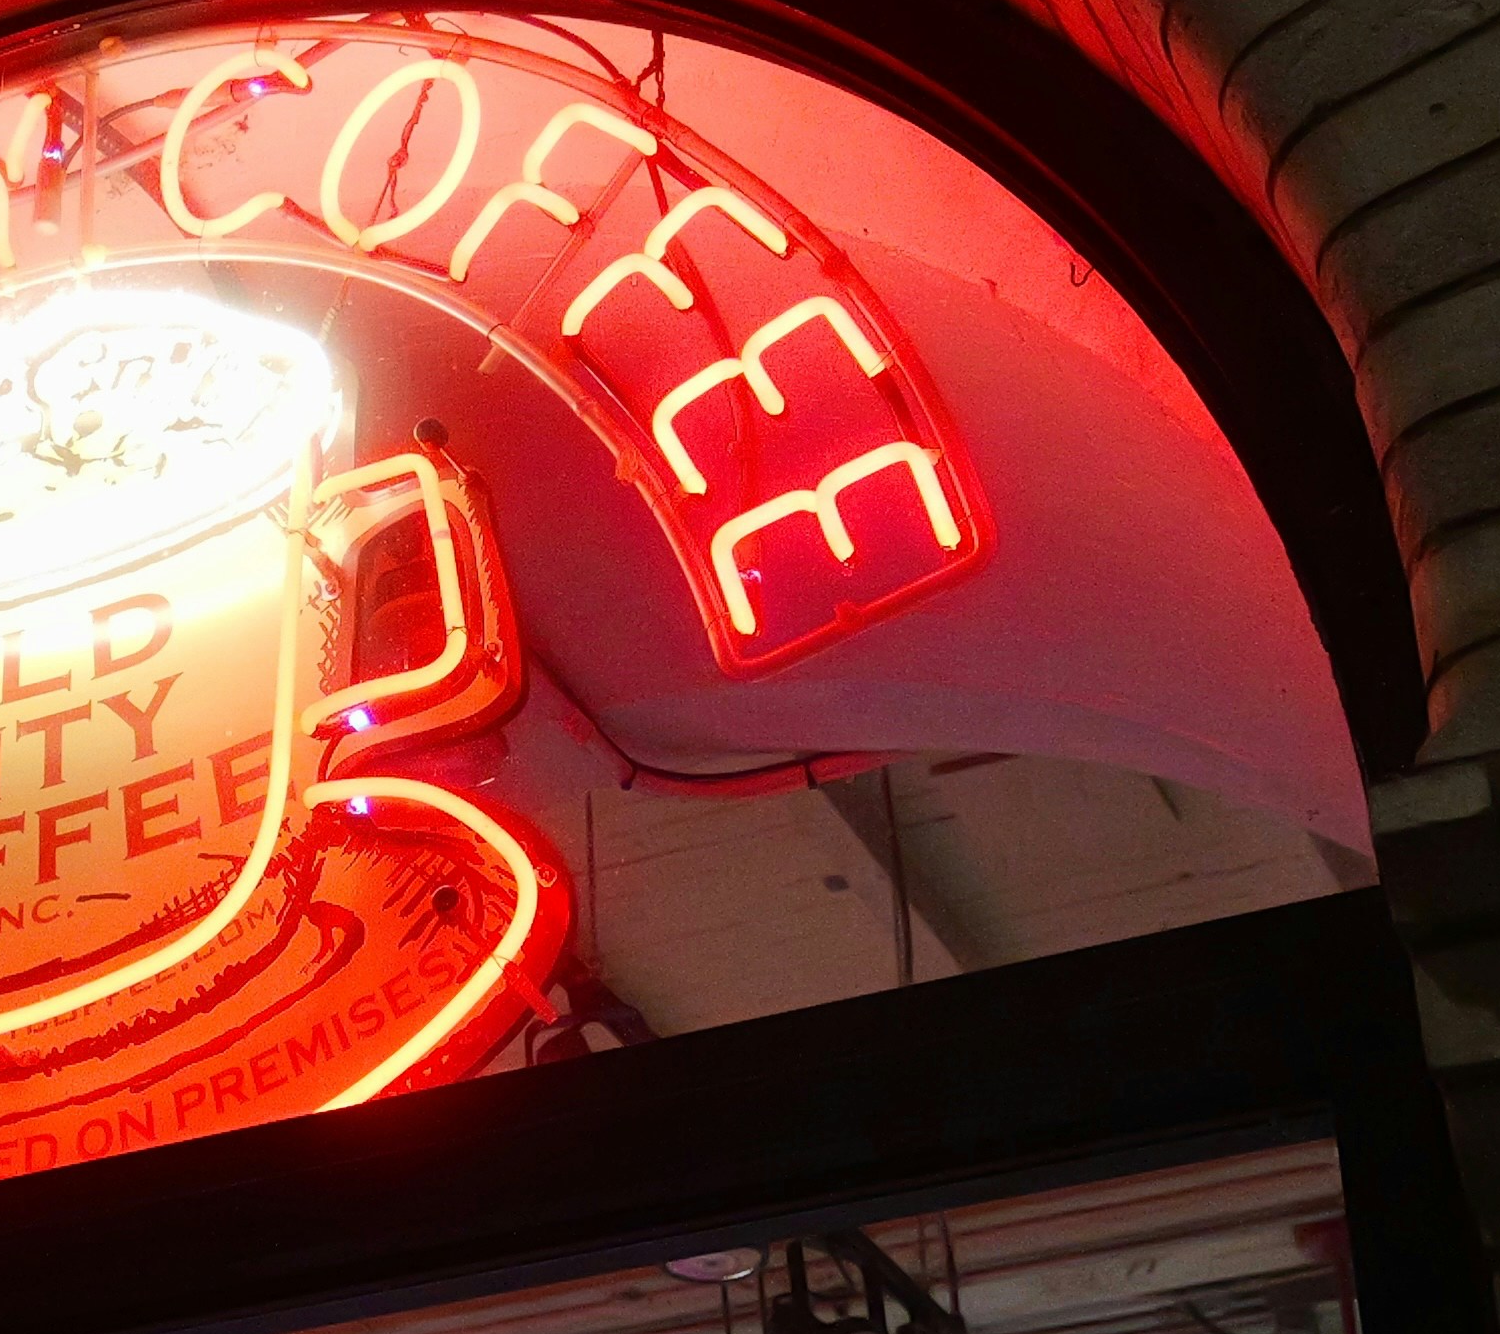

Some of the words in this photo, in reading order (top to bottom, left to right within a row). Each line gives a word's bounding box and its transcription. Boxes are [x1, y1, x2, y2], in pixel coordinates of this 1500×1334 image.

[160, 48, 962, 636] COFFEE
[76, 1100, 157, 1161] ON
[171, 948, 457, 1131] PREMISES
